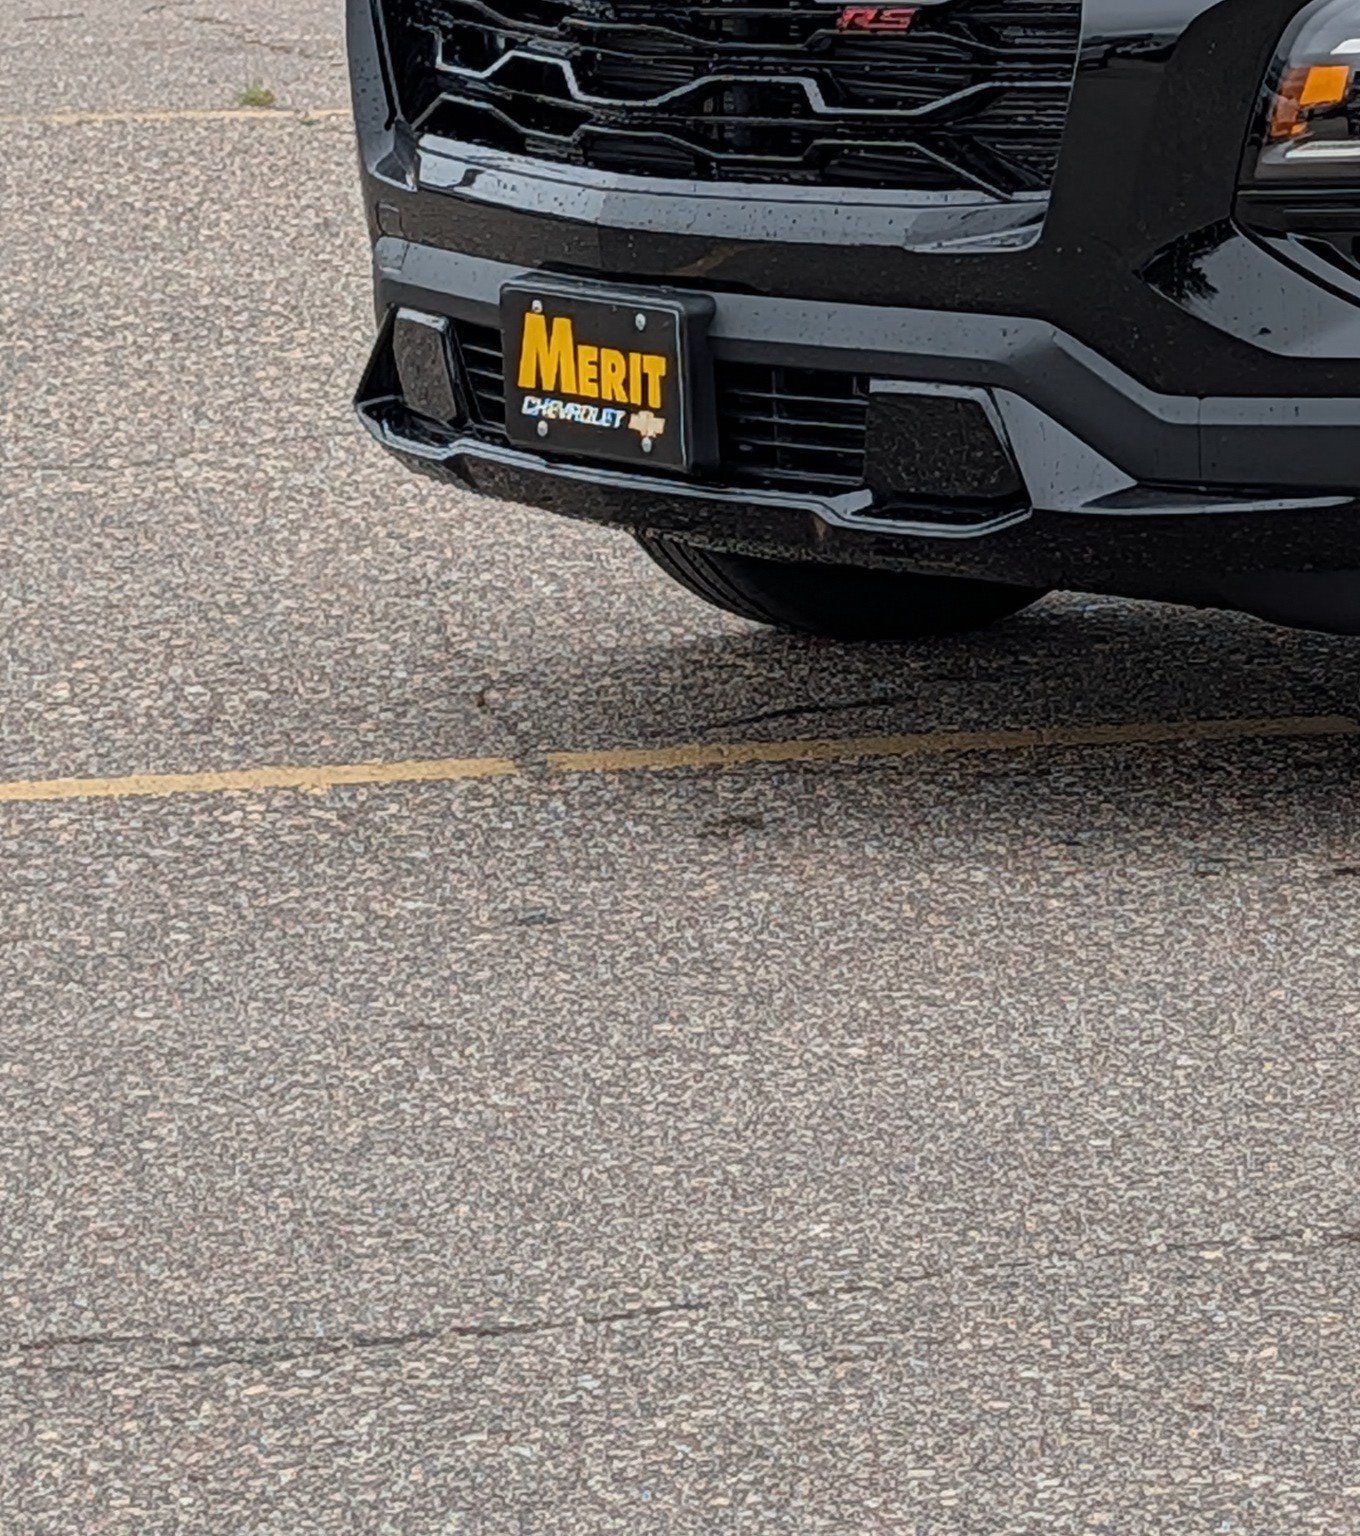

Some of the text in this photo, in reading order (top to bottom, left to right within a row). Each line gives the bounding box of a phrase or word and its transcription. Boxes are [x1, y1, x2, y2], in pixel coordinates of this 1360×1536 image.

[836, 6, 916, 30] RS
[517, 312, 667, 409] MERIT
[521, 395, 627, 430] CHEVROLET
